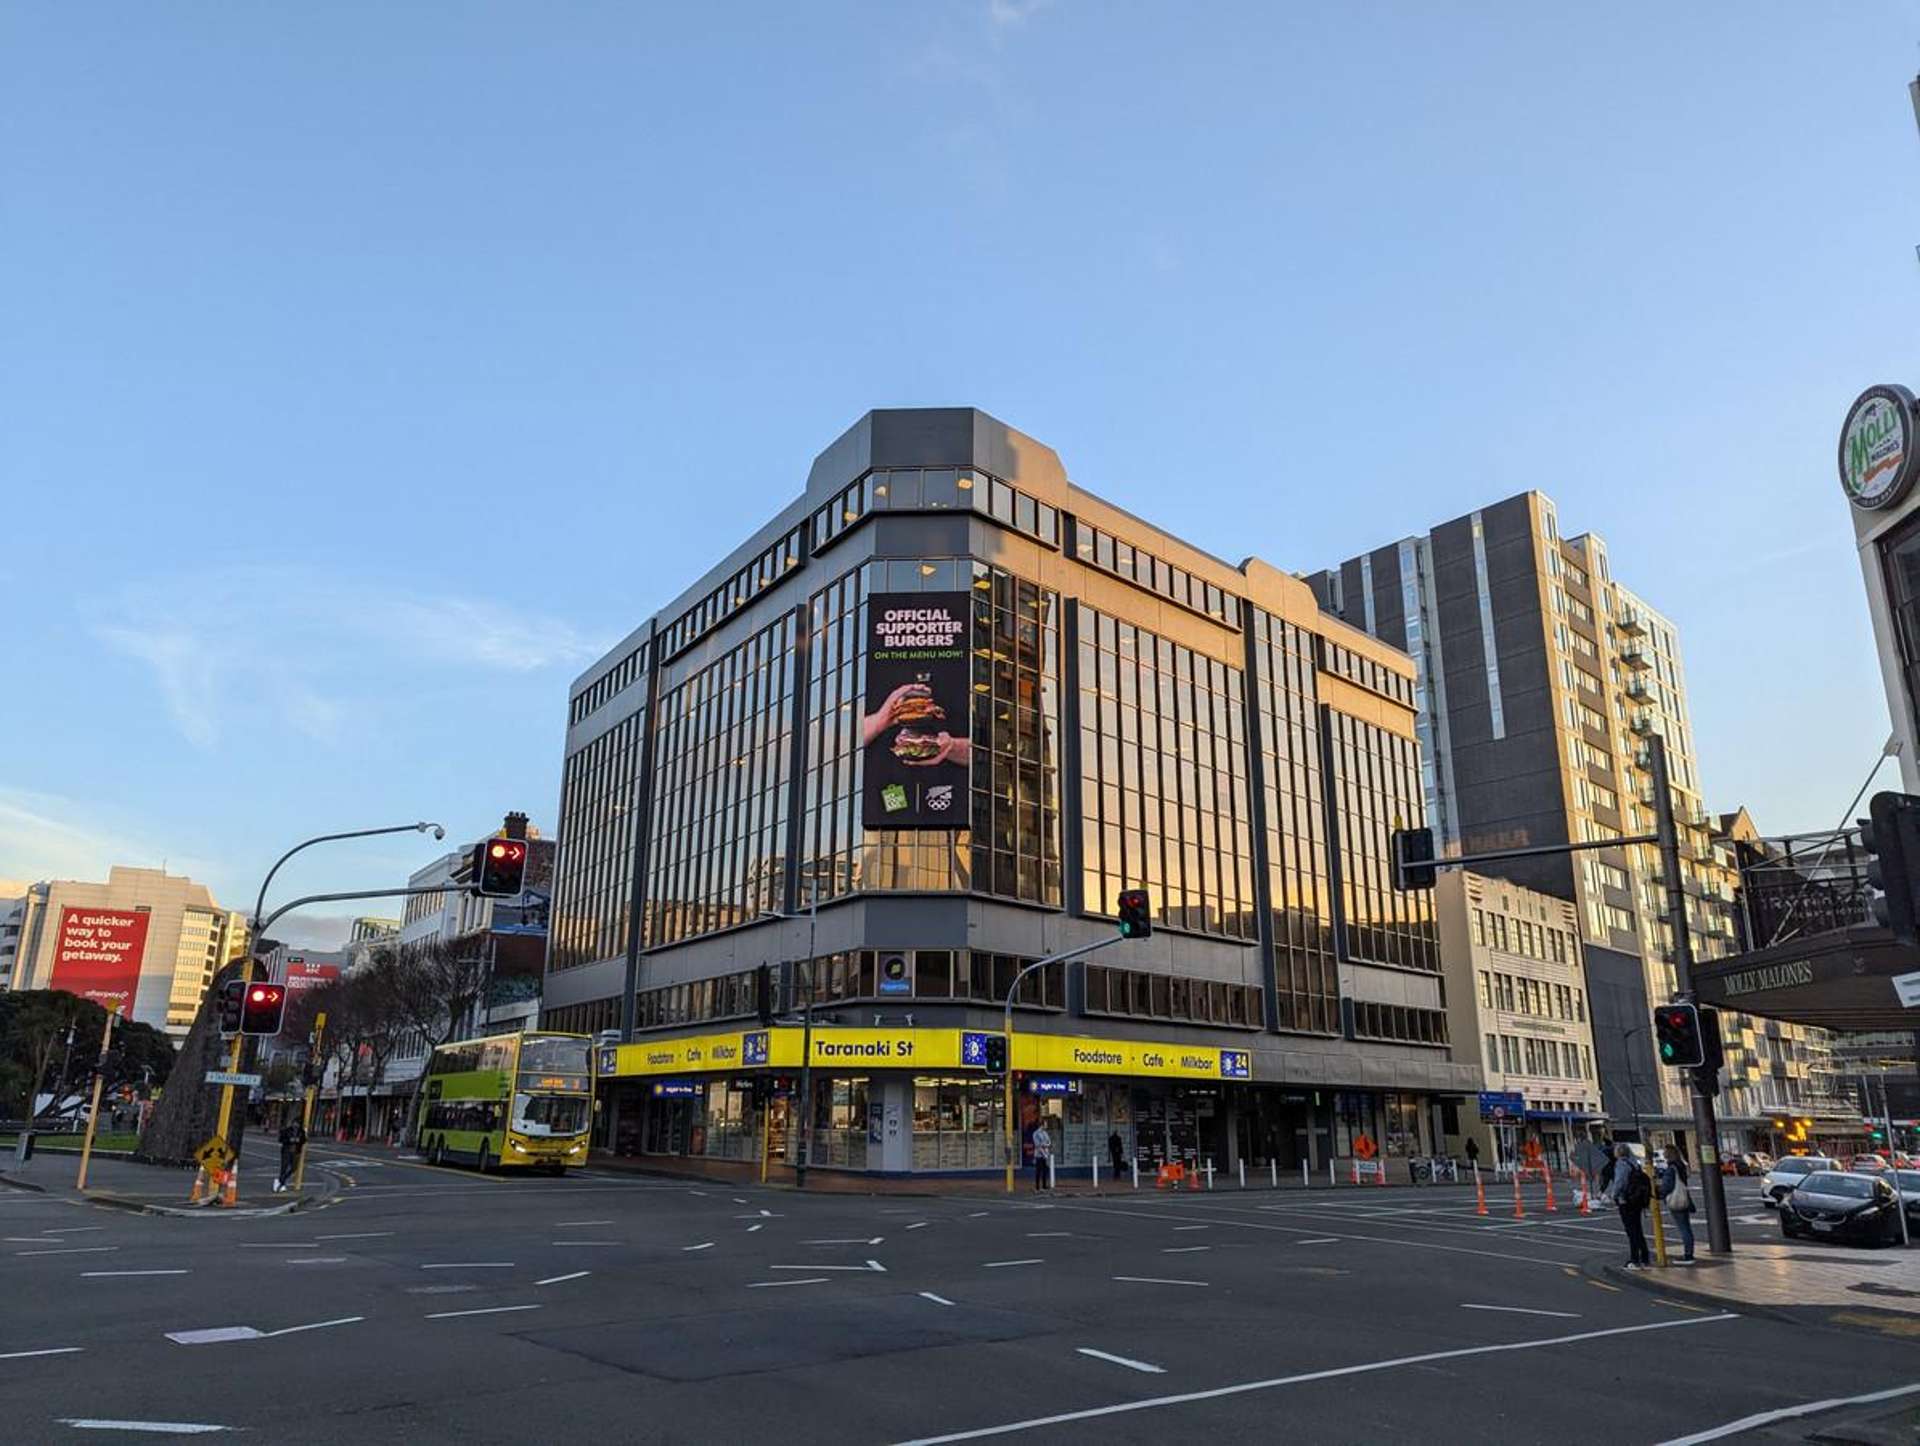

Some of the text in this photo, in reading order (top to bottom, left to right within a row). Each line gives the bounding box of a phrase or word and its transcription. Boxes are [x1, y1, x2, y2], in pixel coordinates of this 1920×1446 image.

[884, 608, 951, 622] OFFICIAL
[875, 621, 963, 635] SUPPORTER
[884, 634, 954, 647] BURGERS
[874, 651, 888, 660] ON
[890, 651, 908, 660] THE
[909, 650, 936, 660] MENU
[68, 913, 134, 927] A quicker
[66, 927, 112, 938] way to
[64, 937, 132, 951] book your
[62, 950, 123, 963] getaway.
[1758, 960, 1814, 991] MALONES
[687, 1047, 702, 1062] Cafe
[816, 1040, 913, 1056] Taranaki St
[1074, 1049, 1213, 1069] Foodstore Cafe Milkbar
[1235, 1054, 1247, 1068] 24
